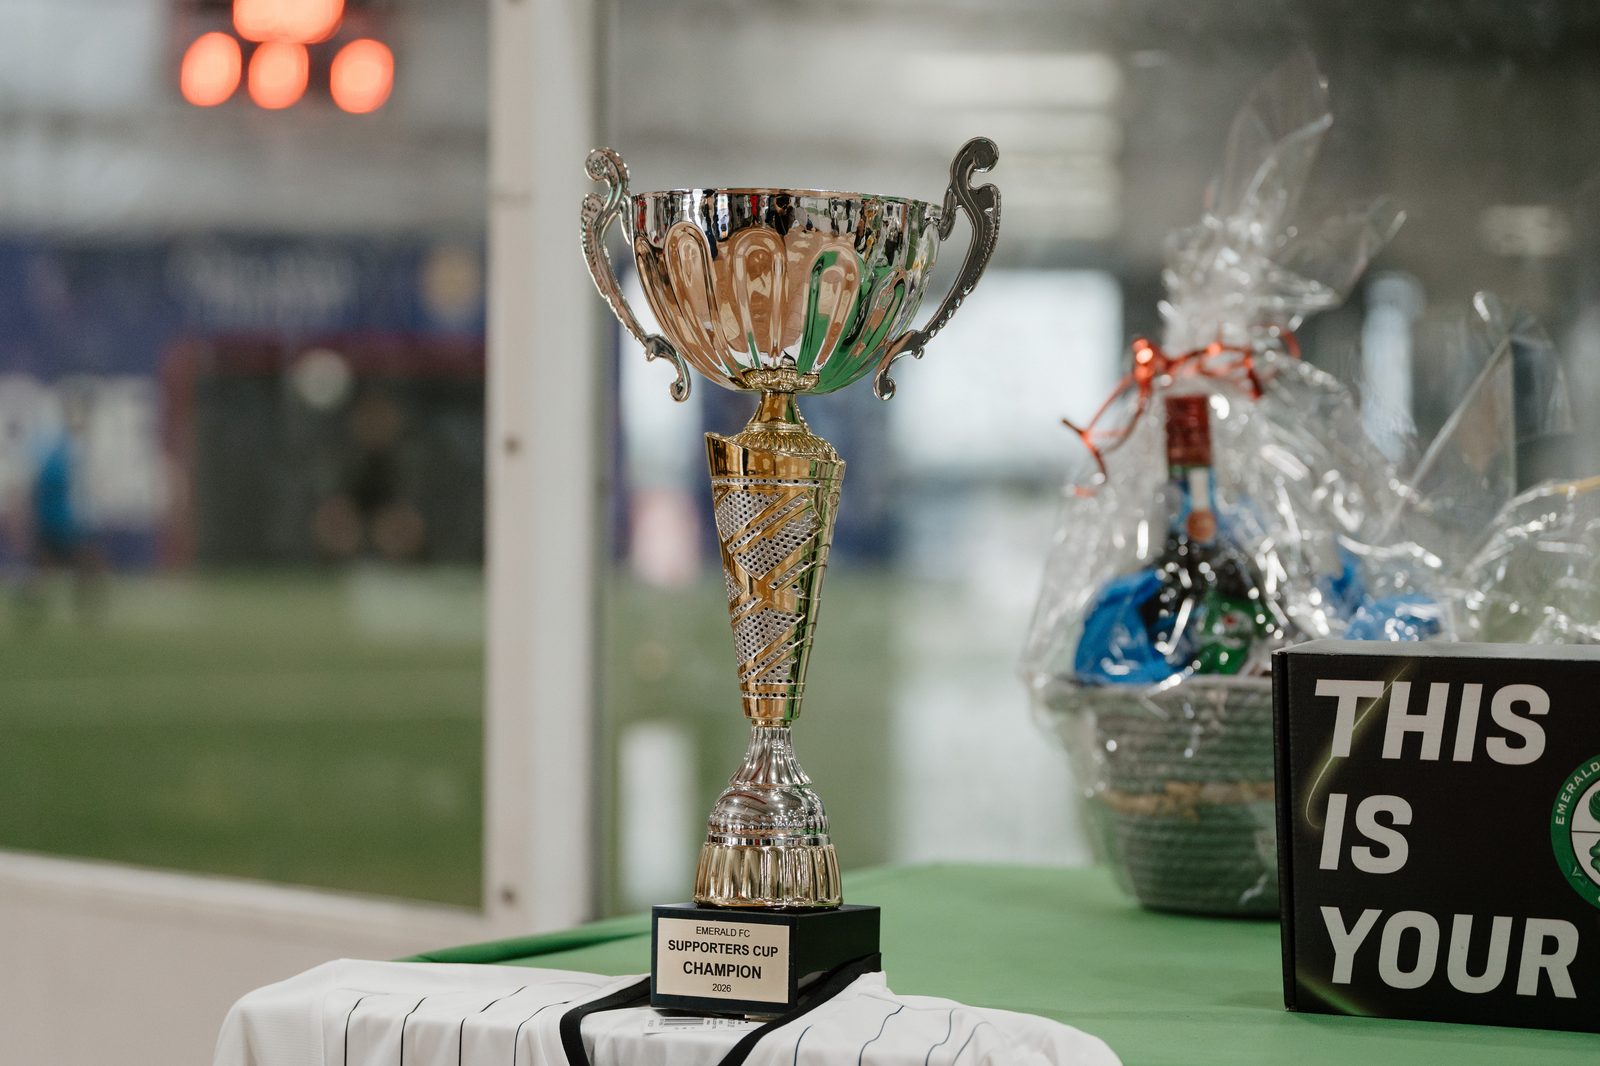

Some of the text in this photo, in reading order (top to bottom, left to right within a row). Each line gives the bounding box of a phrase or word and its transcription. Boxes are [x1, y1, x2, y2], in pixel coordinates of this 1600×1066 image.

[1314, 679, 1551, 765] THIS
[1555, 762, 1600, 825] EMERALD
[1319, 793, 1413, 874] IS
[668, 939, 779, 957] SUPPORTERS CUP
[696, 926, 750, 937] EMERALD FC
[683, 961, 762, 979] CHAMPION
[1319, 906, 1580, 999] YOUR
[712, 983, 732, 993] 2026
